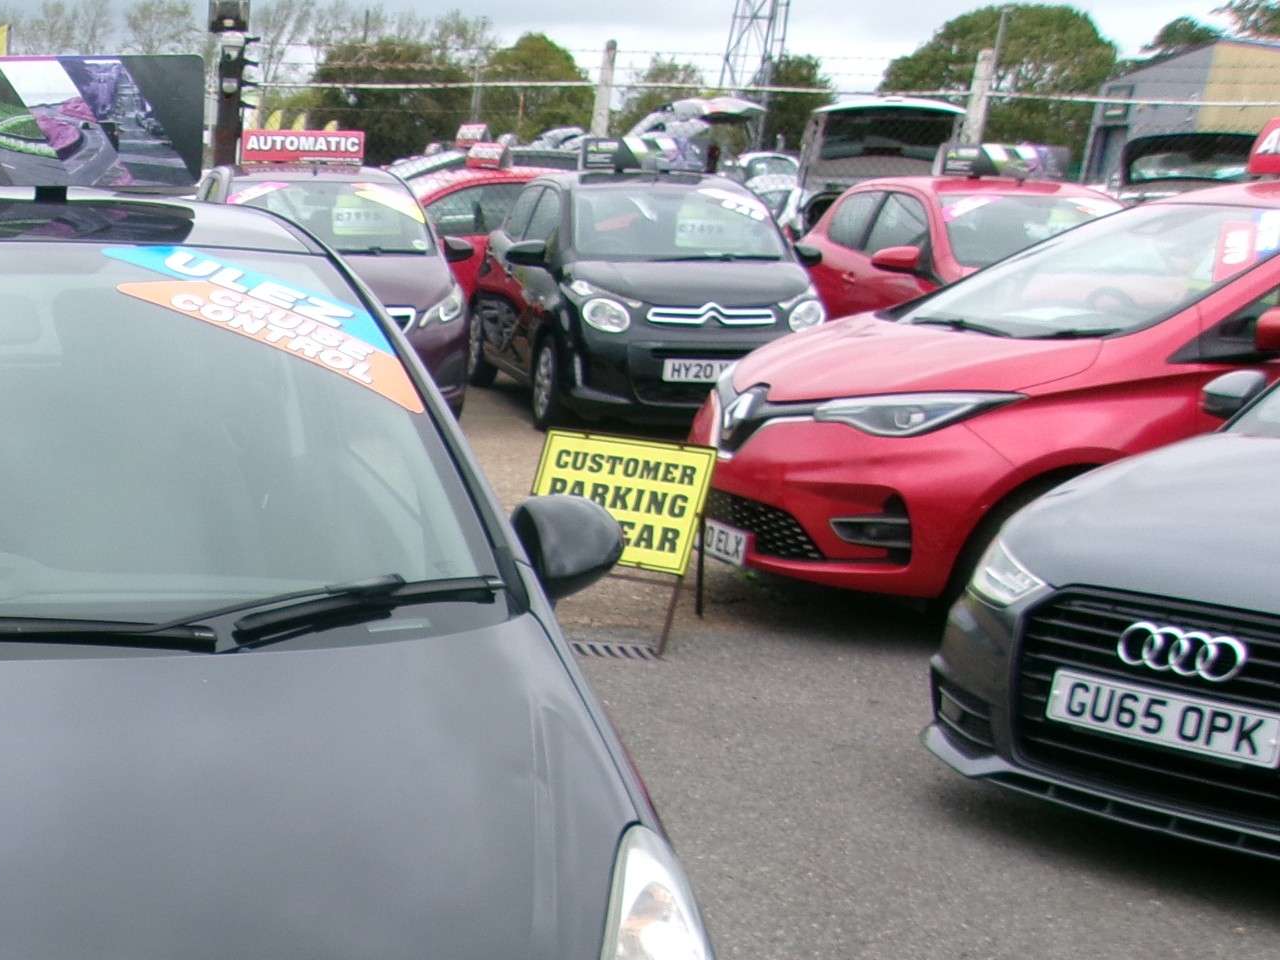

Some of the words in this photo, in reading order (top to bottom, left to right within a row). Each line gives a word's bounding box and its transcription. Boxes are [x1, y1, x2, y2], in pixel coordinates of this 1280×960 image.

[246, 135, 361, 152] AUTOMATIC
[164, 250, 354, 329] ULEZ
[170, 293, 373, 384] CONTROL
[208, 288, 375, 361] CRUISE
[671, 362, 714, 379] HY20
[555, 449, 697, 486] CUSTOMER
[549, 477, 689, 518] PARKING
[619, 520, 680, 553] EAR
[1065, 682, 1168, 735] GU65
[1177, 706, 1264, 756] OPK
